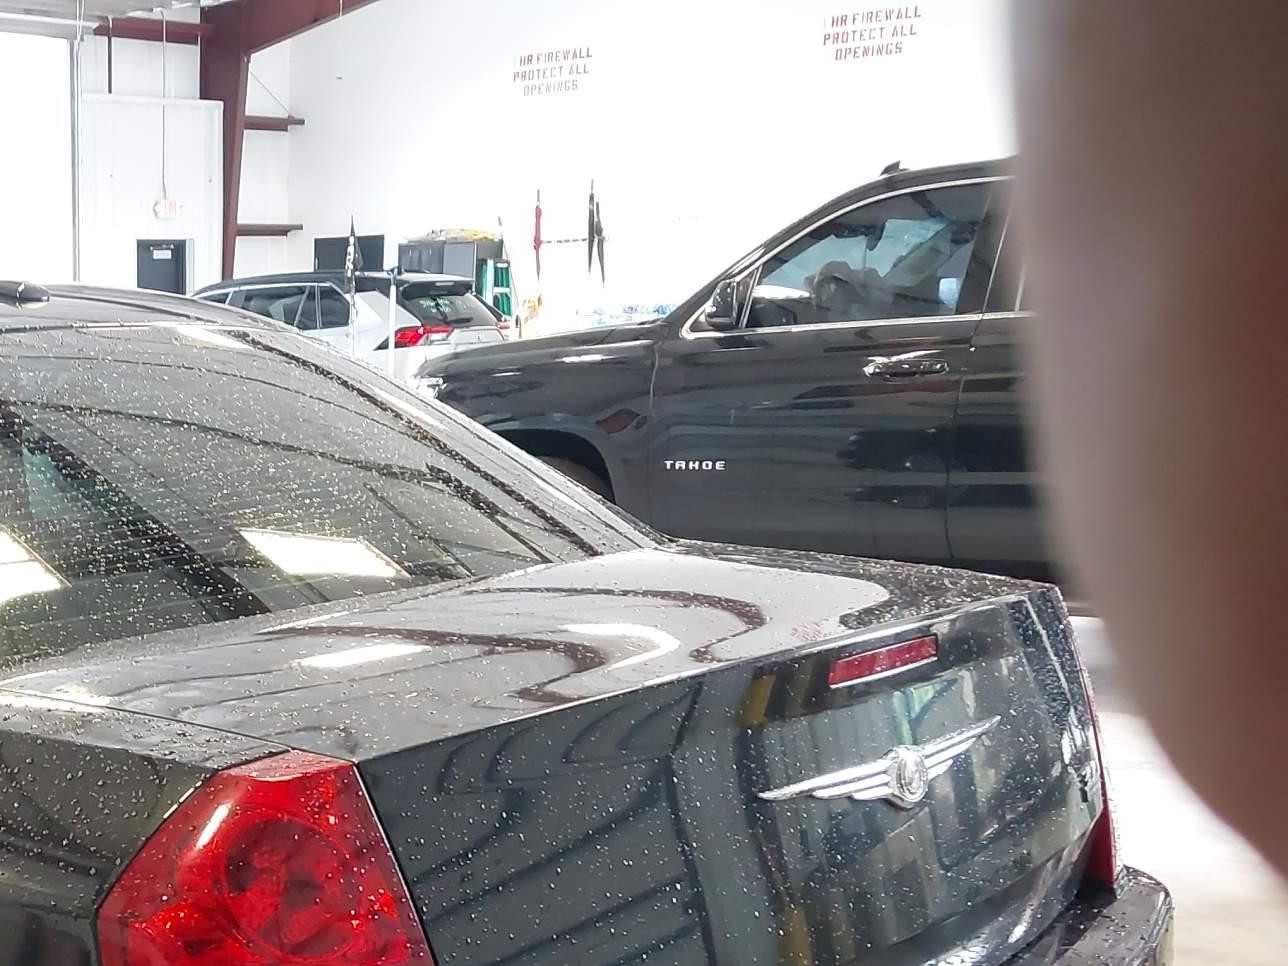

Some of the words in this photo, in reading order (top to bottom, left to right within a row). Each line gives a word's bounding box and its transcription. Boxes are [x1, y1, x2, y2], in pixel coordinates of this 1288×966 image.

[831, 14, 847, 28] HR
[852, 5, 922, 25] FIREWALL
[823, 26, 885, 46] PROTECT
[892, 23, 917, 38] ALL
[519, 54, 533, 67] HR
[536, 46, 593, 65] FIREWALL
[834, 41, 902, 60] OPENINGS
[512, 65, 563, 82] PROTECT
[569, 63, 590, 76] ALL
[523, 79, 578, 97] OPENINGS
[664, 460, 726, 471] TAHOE
